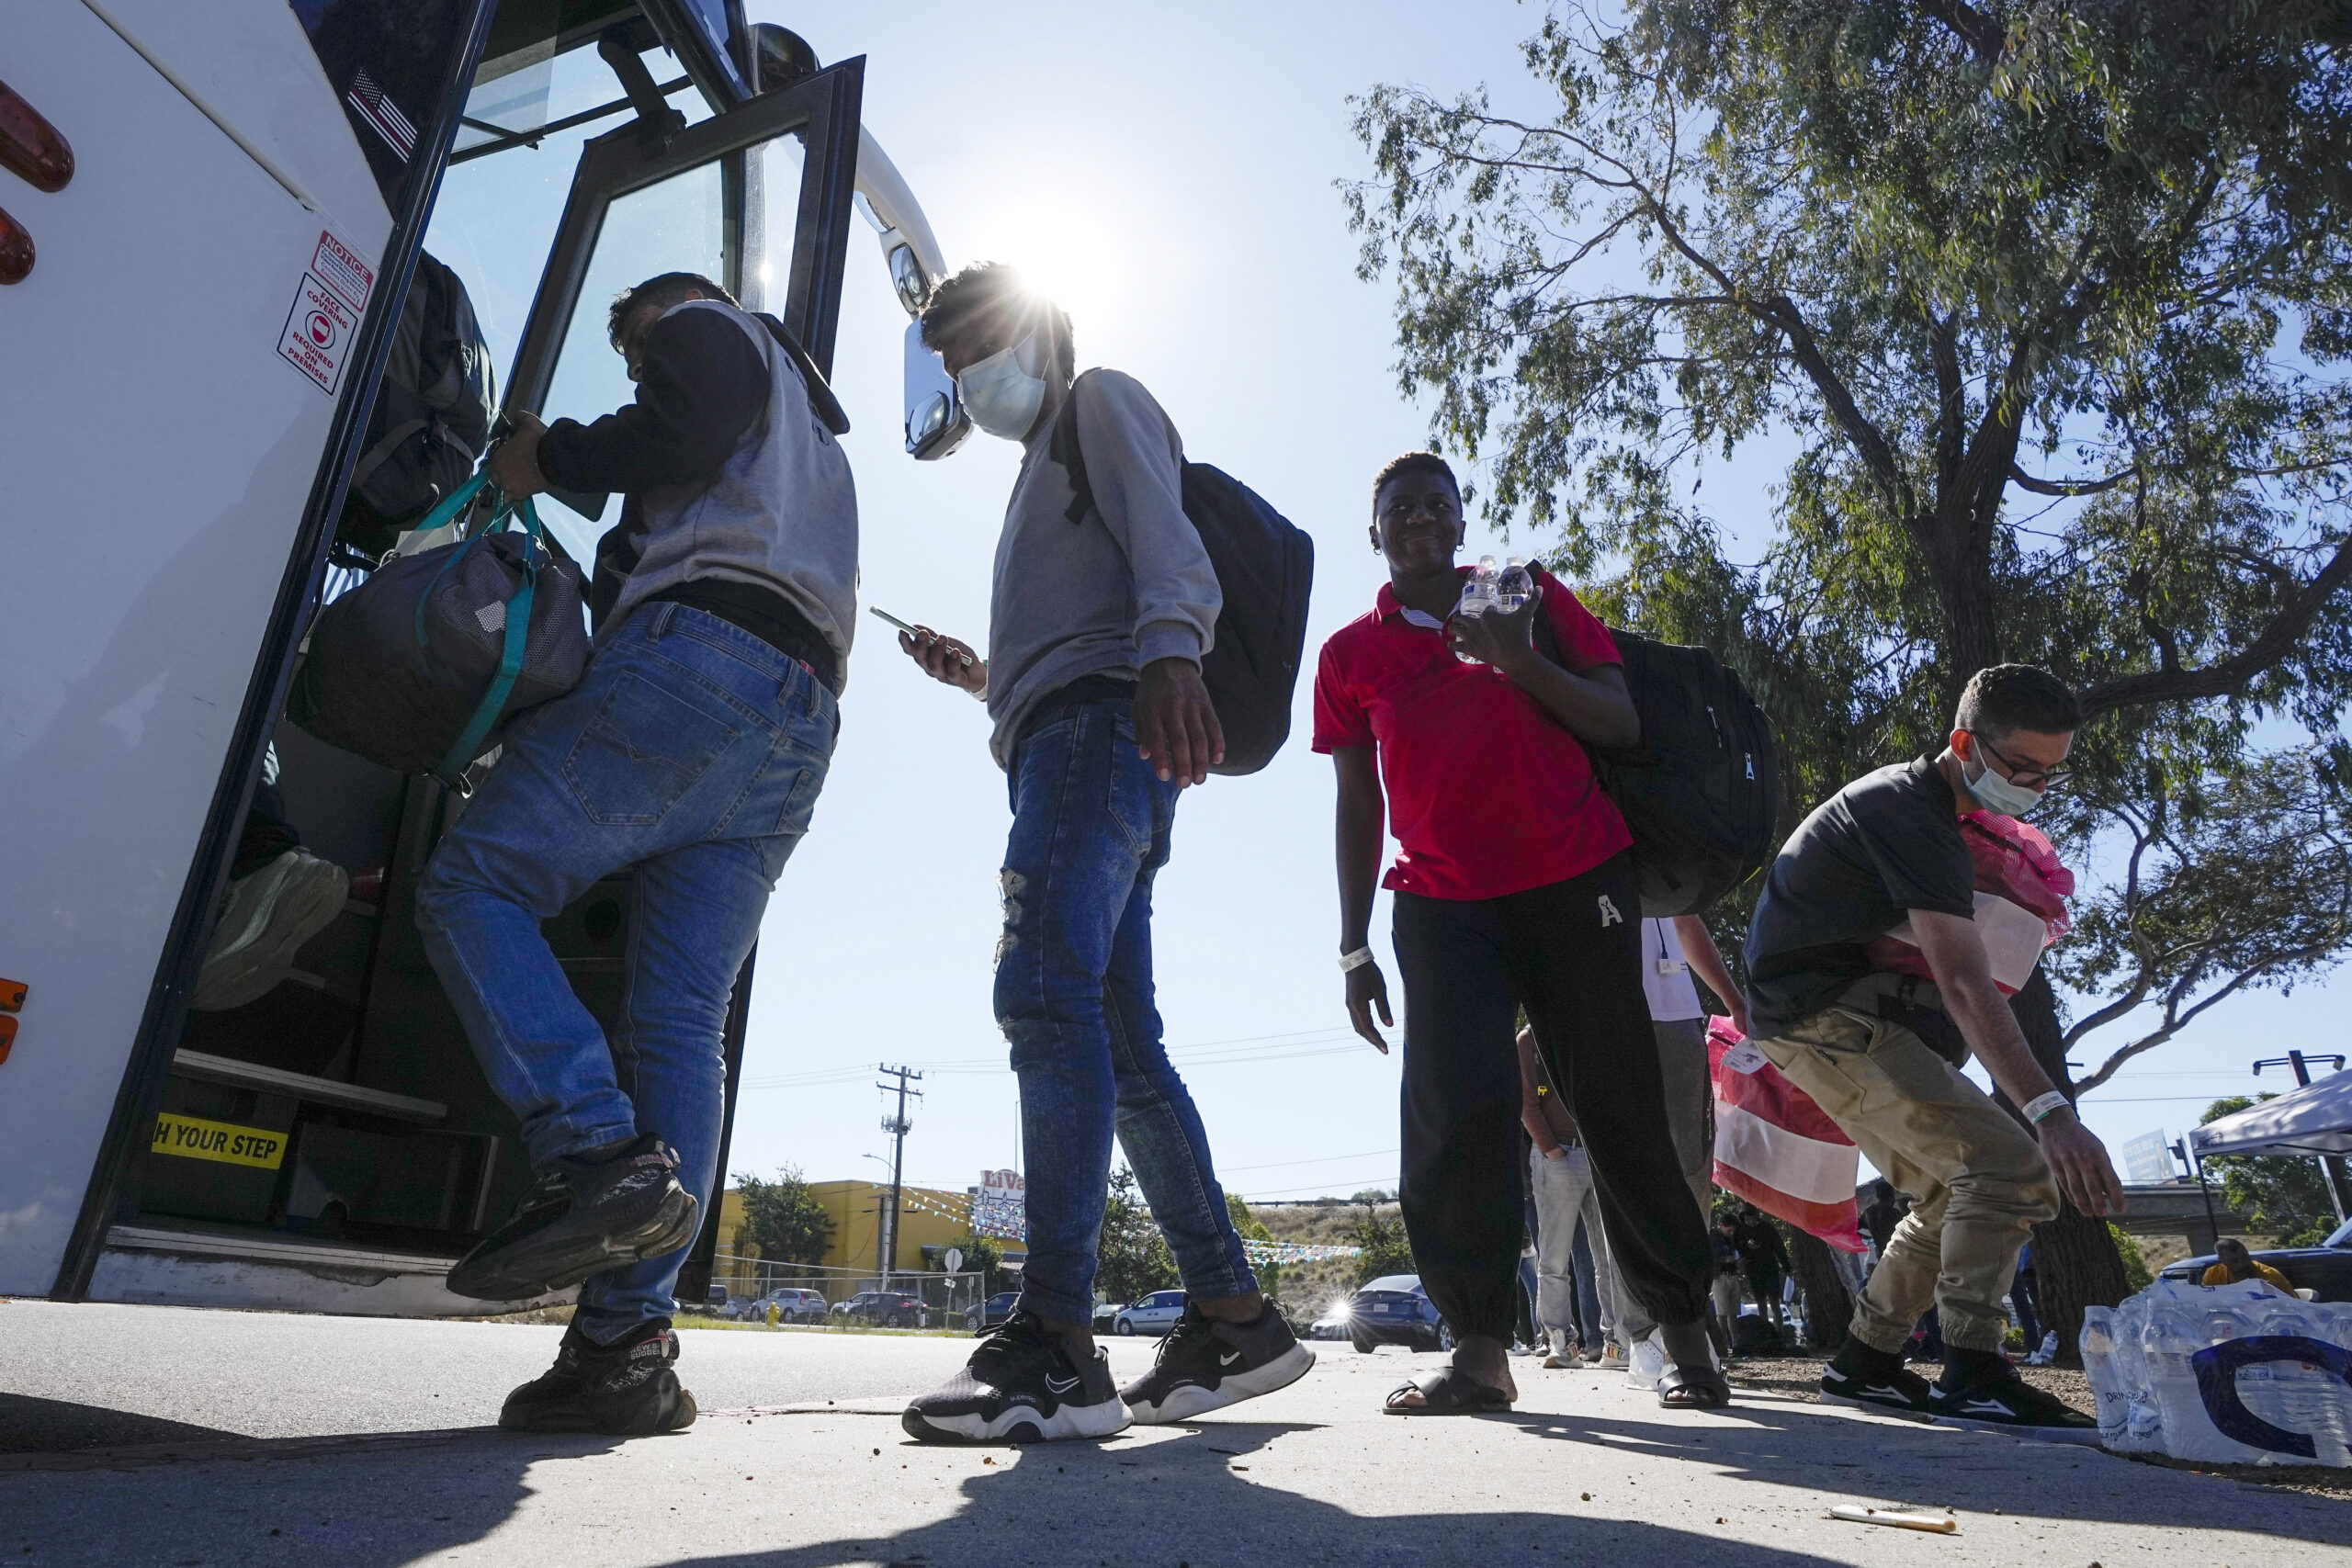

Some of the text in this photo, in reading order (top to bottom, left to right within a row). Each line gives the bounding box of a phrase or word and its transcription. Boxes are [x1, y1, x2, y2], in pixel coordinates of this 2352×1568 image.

[325, 235, 368, 280] NOTICE
[307, 289, 348, 329] COVERING
[321, 292, 341, 312] FACE
[288, 346, 328, 384] PREMISES
[293, 331, 334, 369] REQUIRED
[304, 351, 318, 365] ON
[175, 1124, 228, 1153] YOUR
[232, 1135, 277, 1159] STEP
